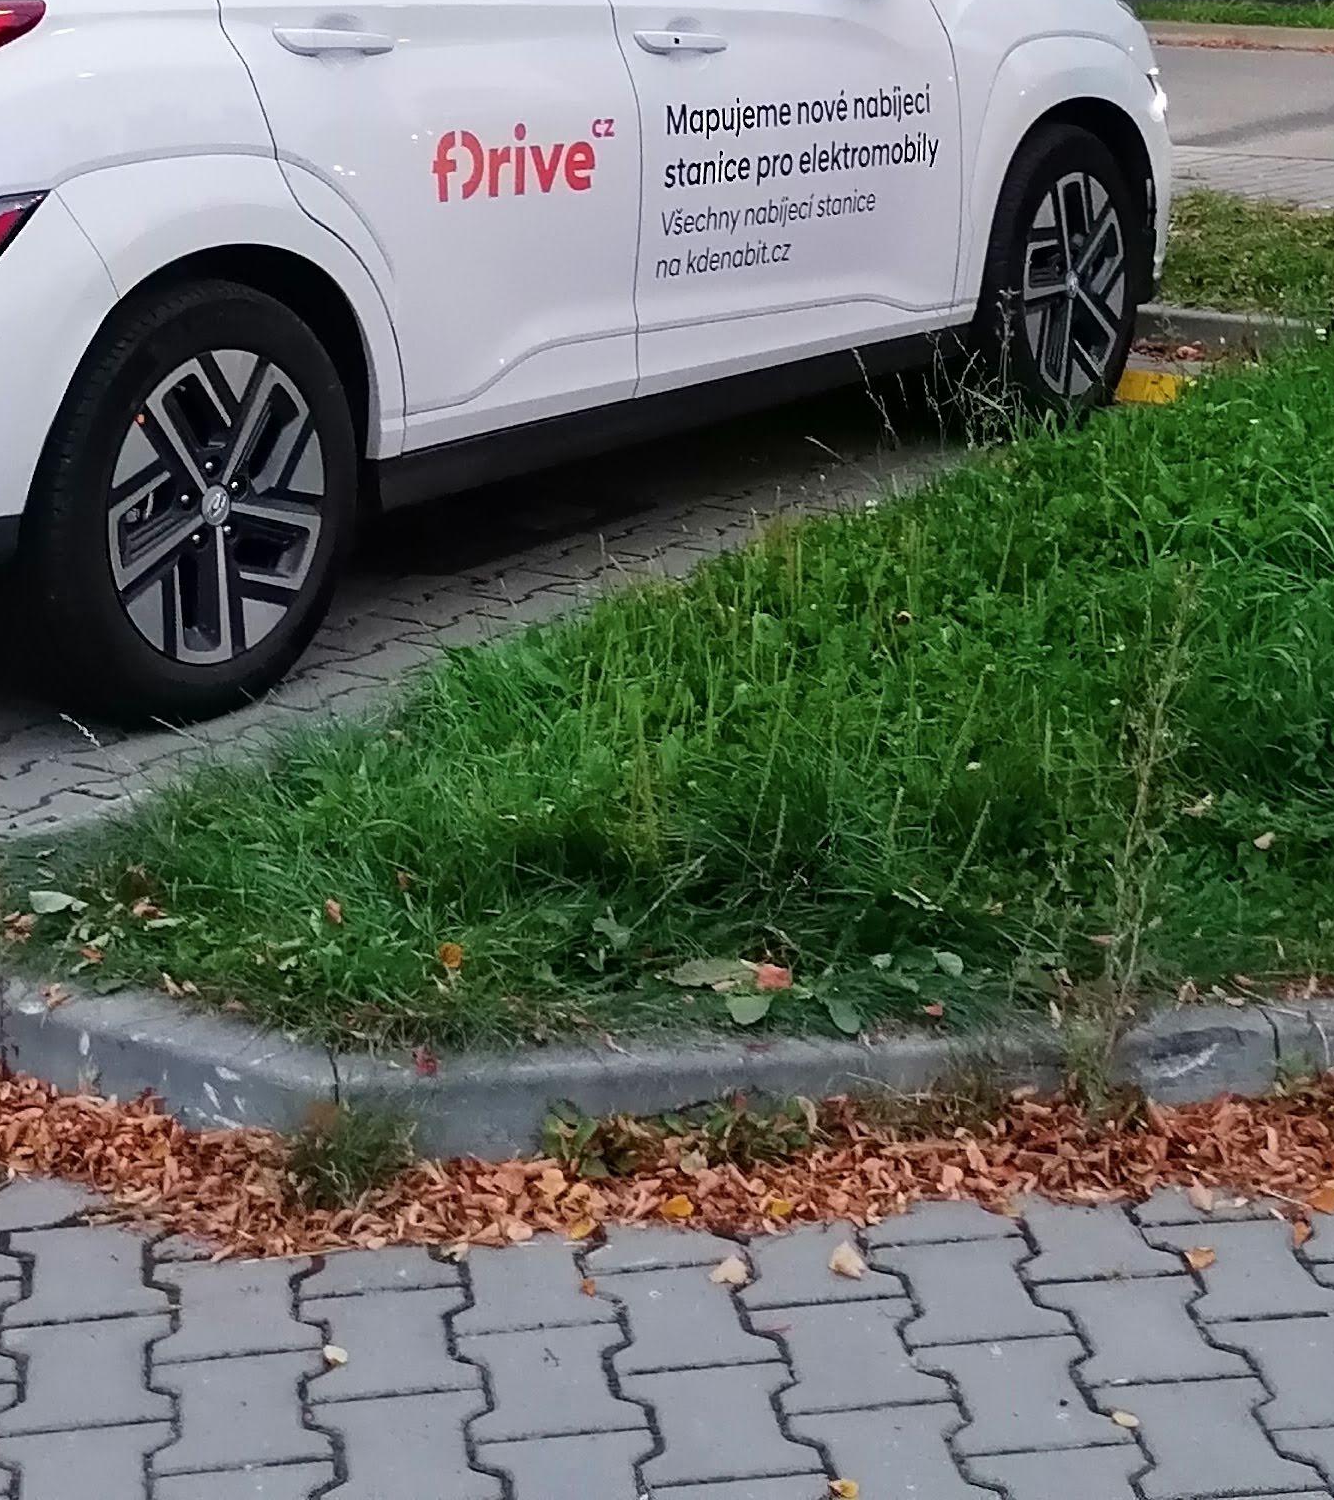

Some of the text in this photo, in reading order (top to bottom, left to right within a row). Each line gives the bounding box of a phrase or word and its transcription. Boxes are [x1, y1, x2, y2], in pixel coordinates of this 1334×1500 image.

[666, 83, 931, 140] Mapujeme nové nabíjecí
[664, 132, 940, 188] stanice pro elektromobily
[661, 188, 876, 236] Všechny nabíjecí stanice
[655, 240, 792, 278] na kdenabit.cz
